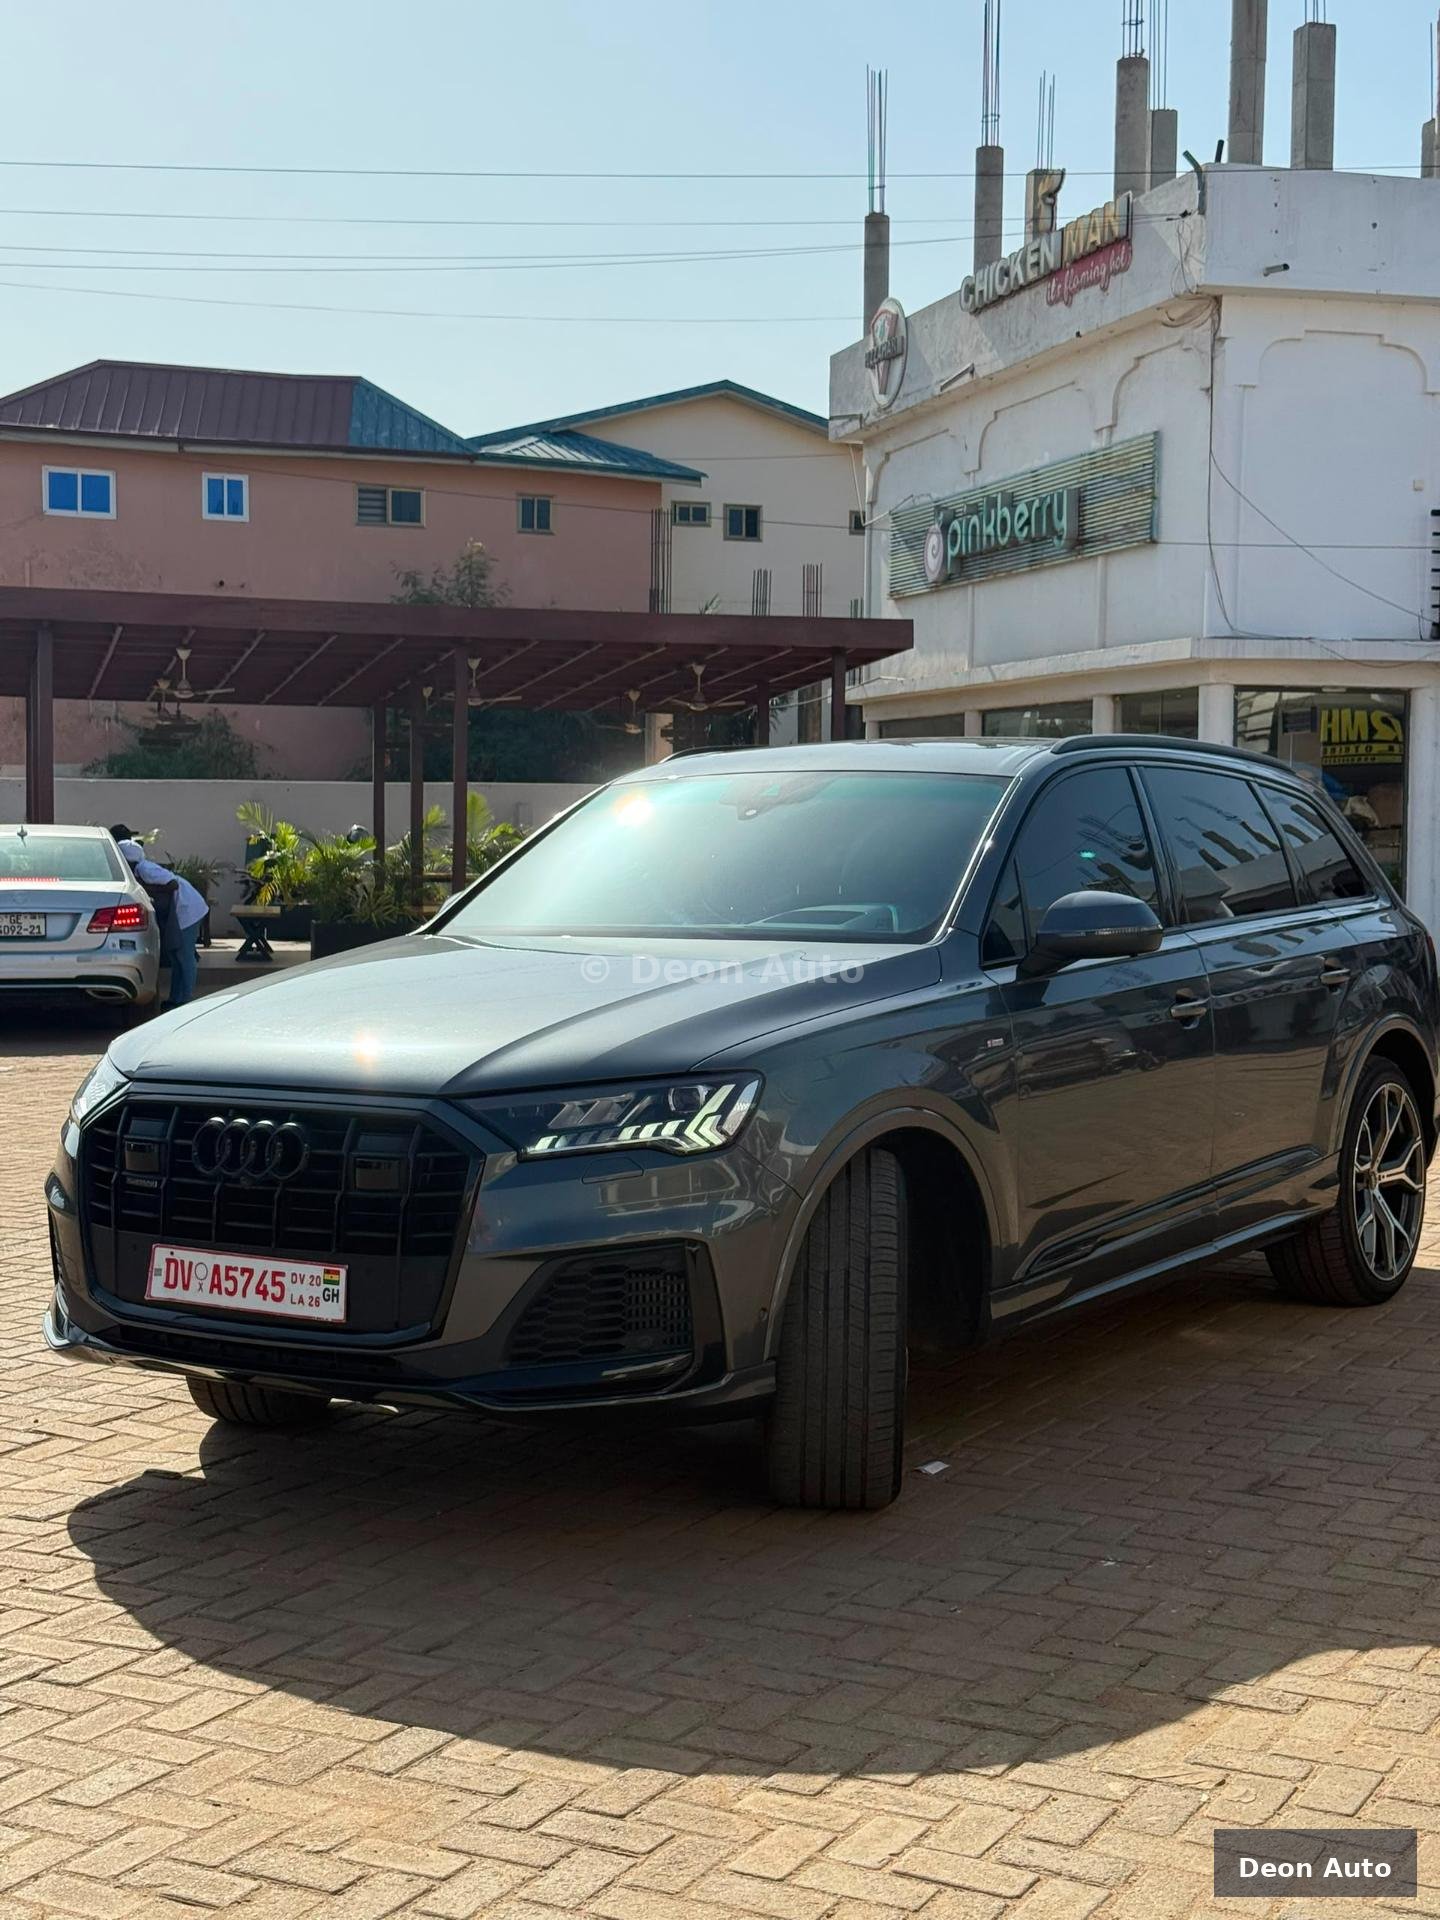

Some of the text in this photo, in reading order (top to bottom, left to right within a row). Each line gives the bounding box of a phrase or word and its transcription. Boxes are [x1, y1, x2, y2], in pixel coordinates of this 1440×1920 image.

[961, 198, 1123, 312] CHICKEN MAN
[947, 488, 1068, 574] pinkberry
[9, 914, 23, 924] GE
[163, 1257, 286, 1303] DV A5745
[290, 1272, 322, 1288] DV 20
[290, 1293, 321, 1308] LA 26
[322, 1287, 340, 1304] GH
